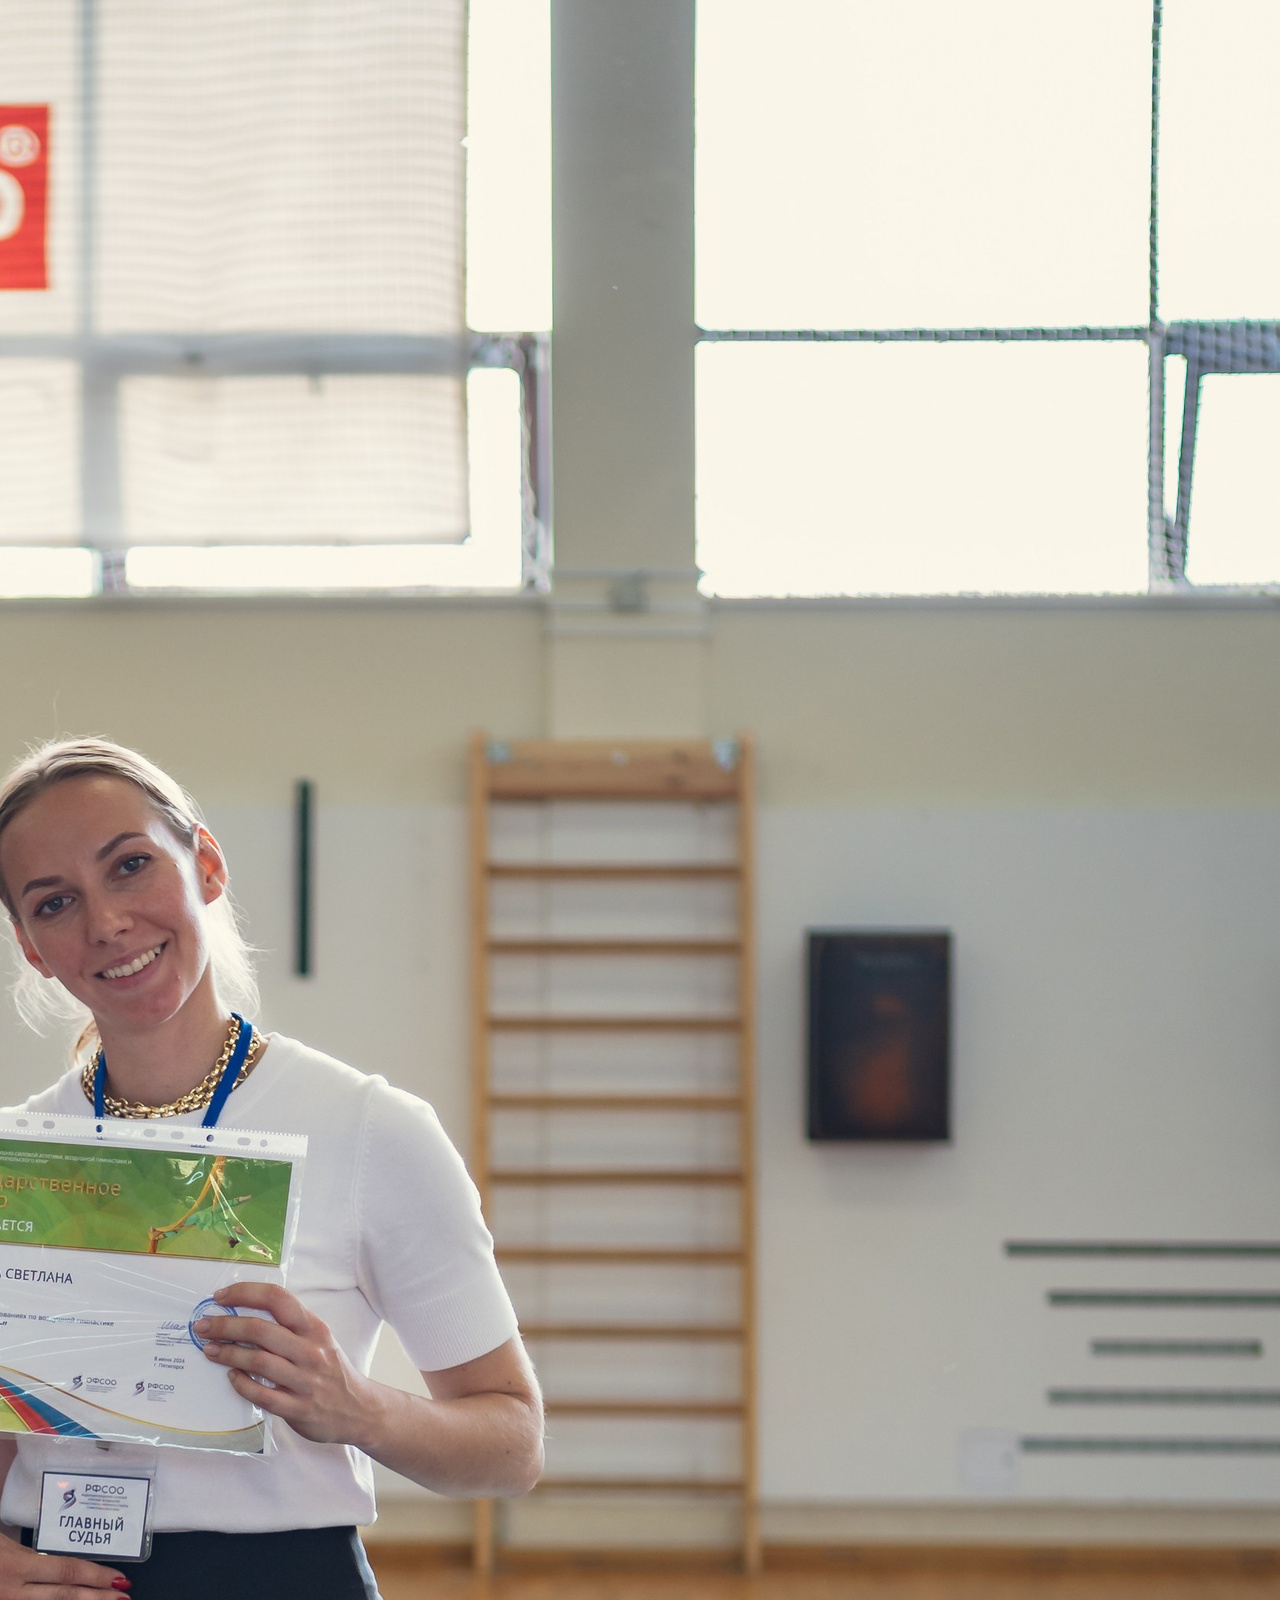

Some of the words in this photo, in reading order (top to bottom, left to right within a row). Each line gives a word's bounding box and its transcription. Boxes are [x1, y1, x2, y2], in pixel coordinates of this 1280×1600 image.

[5, 1268, 73, 1284] СВЕТЛАНА
[147, 1382, 175, 1391] РФСОО
[85, 1483, 124, 1495] РФСОО
[59, 1515, 124, 1532] ГЛАВНЫЙ
[68, 1530, 111, 1546] СУДЬЯ
